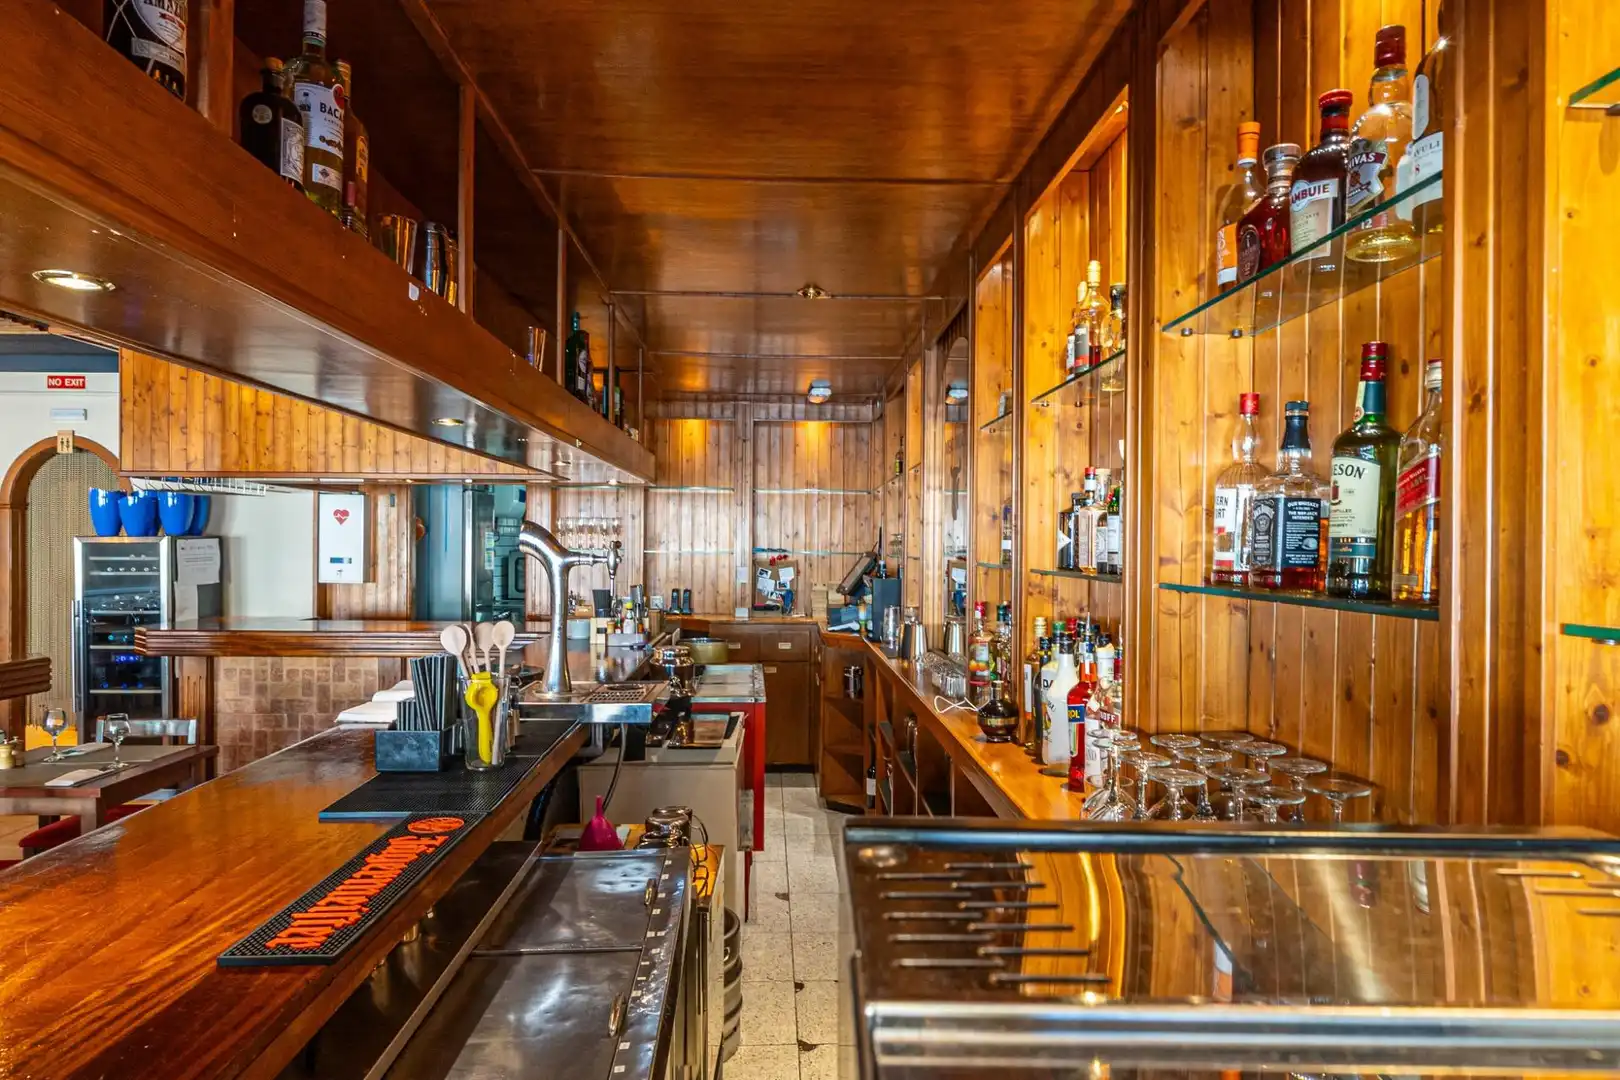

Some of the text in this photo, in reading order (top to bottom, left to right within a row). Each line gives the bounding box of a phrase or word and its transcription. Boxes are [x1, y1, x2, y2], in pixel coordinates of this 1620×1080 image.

[1361, 218, 1373, 230] 12
[48, 378, 85, 387] NO EXIT
